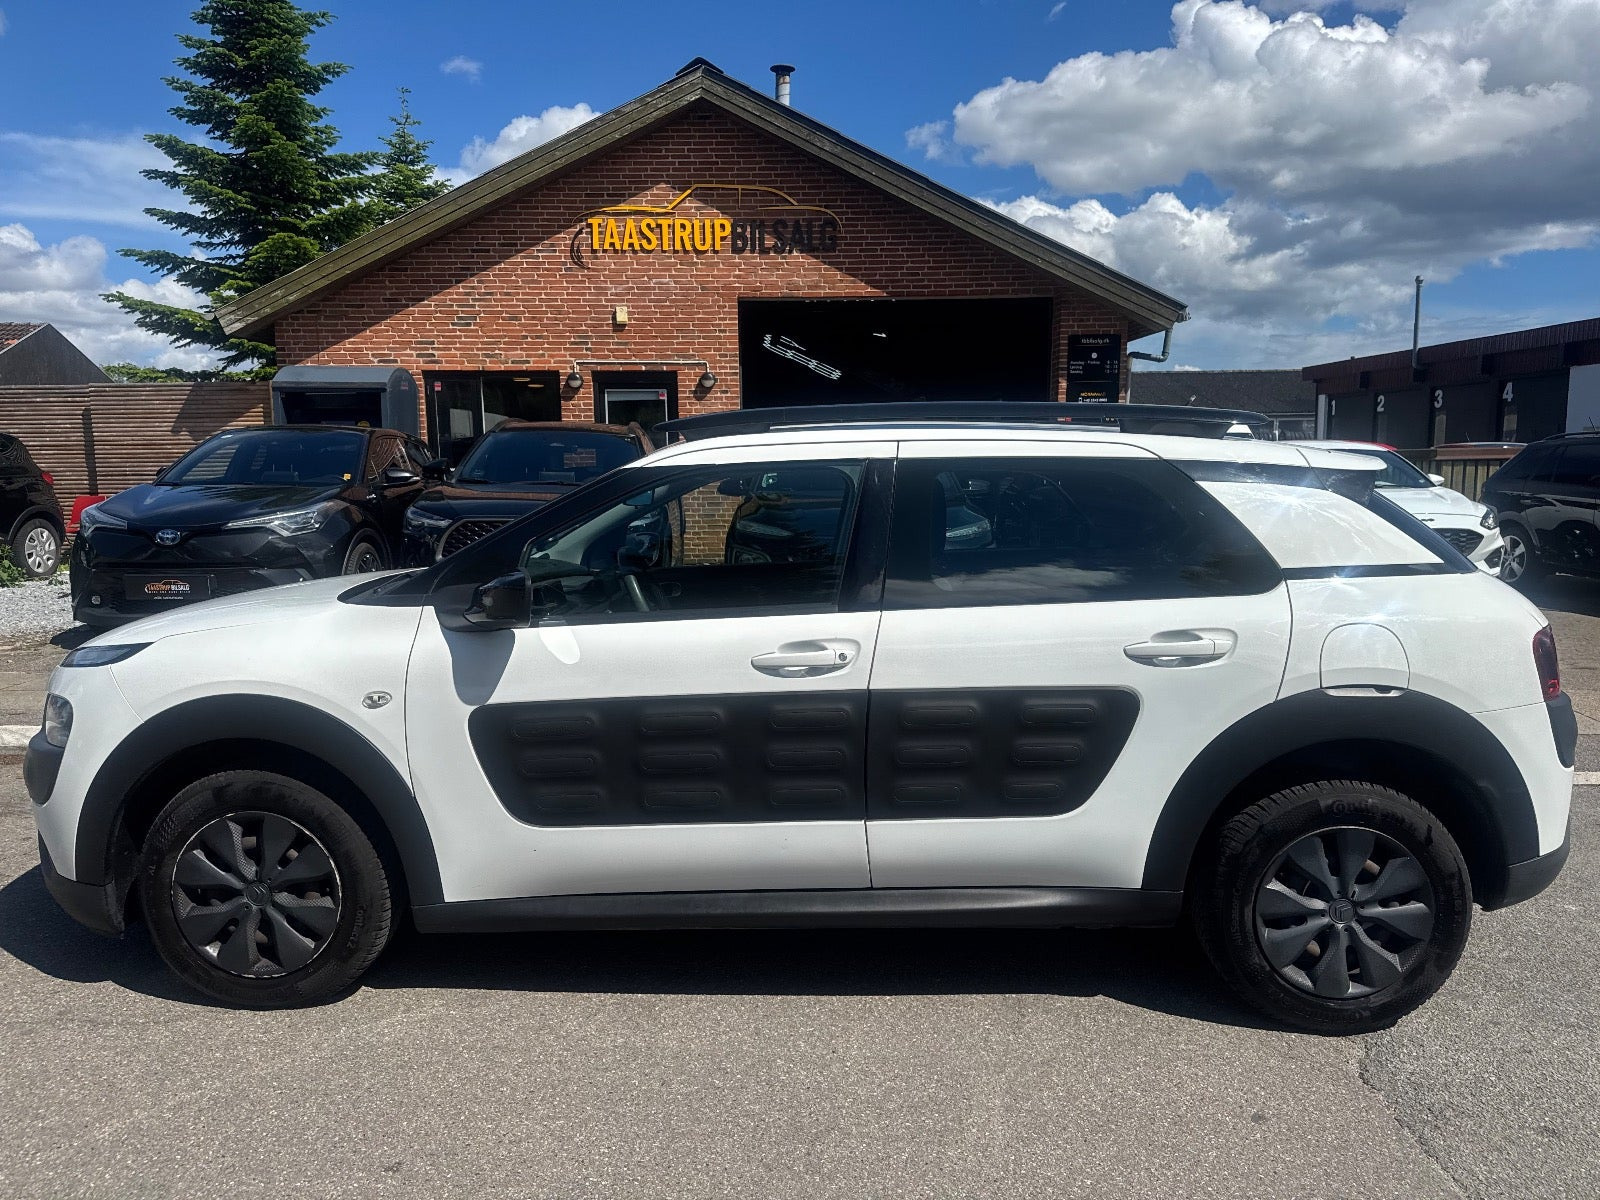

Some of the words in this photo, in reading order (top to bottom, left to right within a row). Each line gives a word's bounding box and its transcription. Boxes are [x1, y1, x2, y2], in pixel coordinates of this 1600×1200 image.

[1434, 389, 1443, 408] 3
[1502, 382, 1514, 402] 4
[1331, 399, 1336, 416] 1
[1376, 395, 1385, 412] 2
